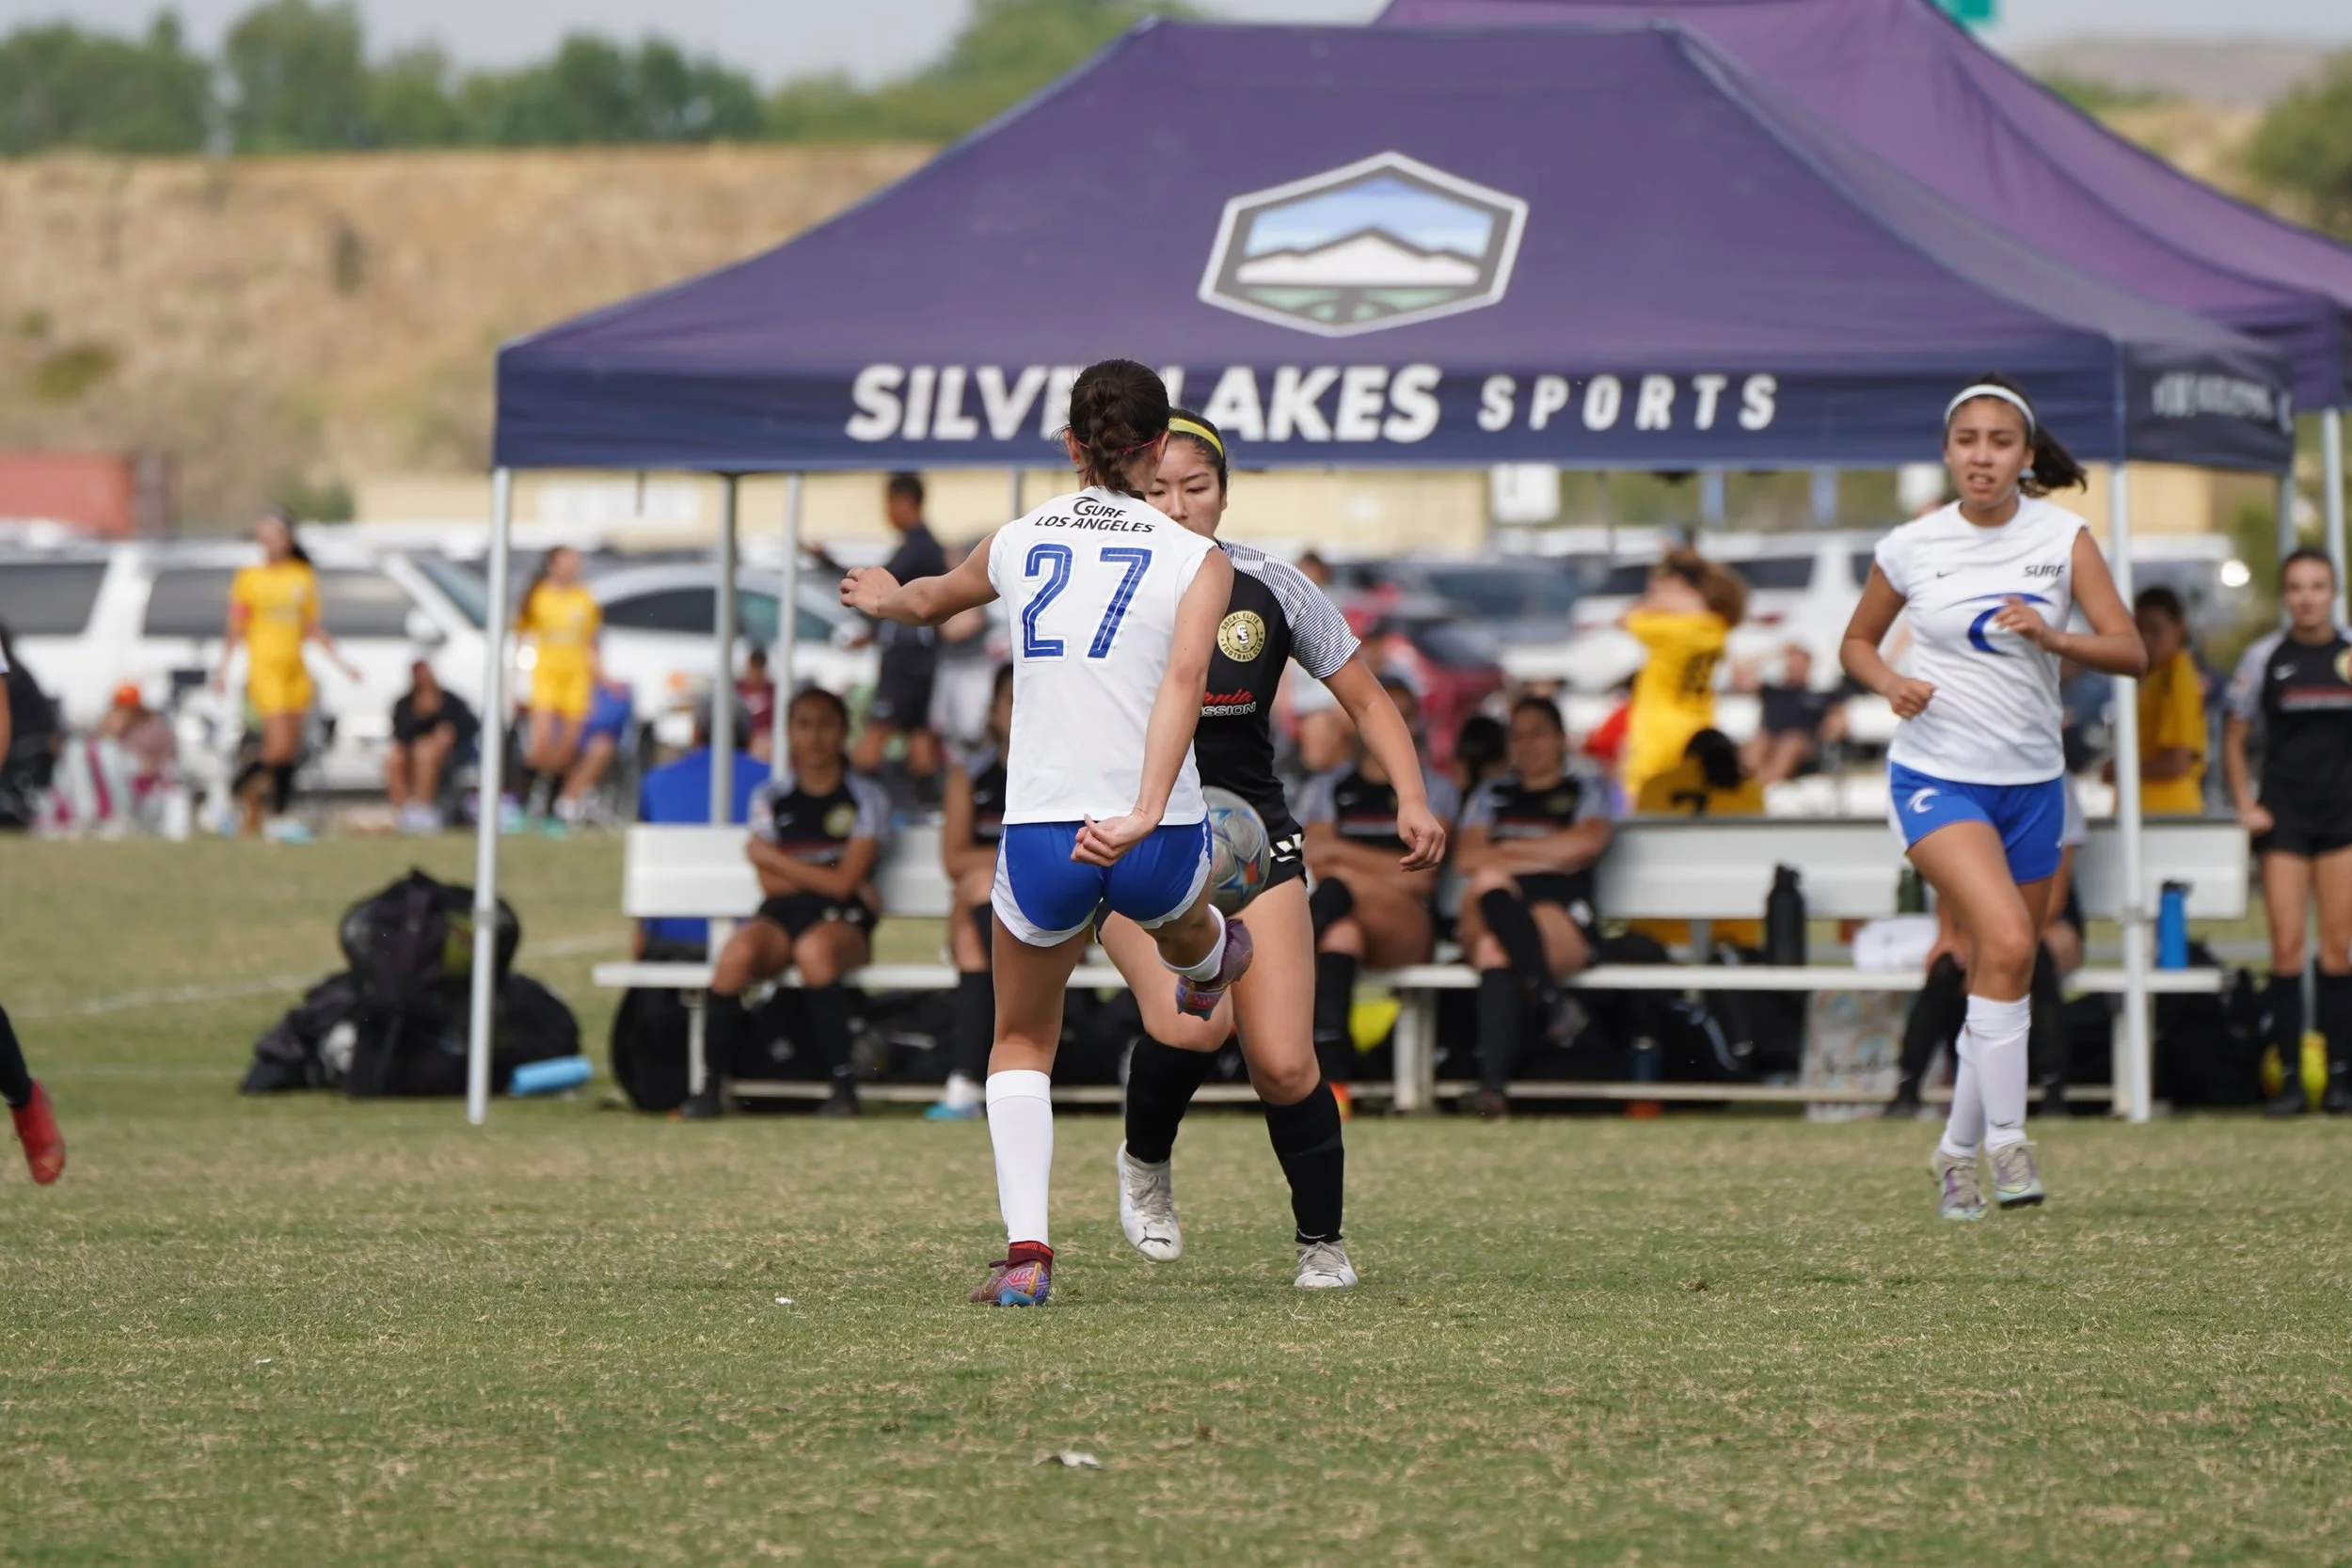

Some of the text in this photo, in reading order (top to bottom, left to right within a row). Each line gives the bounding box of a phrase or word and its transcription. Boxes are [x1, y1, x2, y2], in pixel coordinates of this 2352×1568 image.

[1476, 374, 1777, 432] SPORTS
[1085, 505, 1127, 518] SURF
[1034, 515, 1156, 533] LOS ANGELES
[2023, 564, 2066, 578] SURF
[1022, 543, 1153, 659] 27
[1221, 613, 1261, 630] SOCAL ELITE
[1222, 638, 1263, 659] FOOTBALL CLUB
